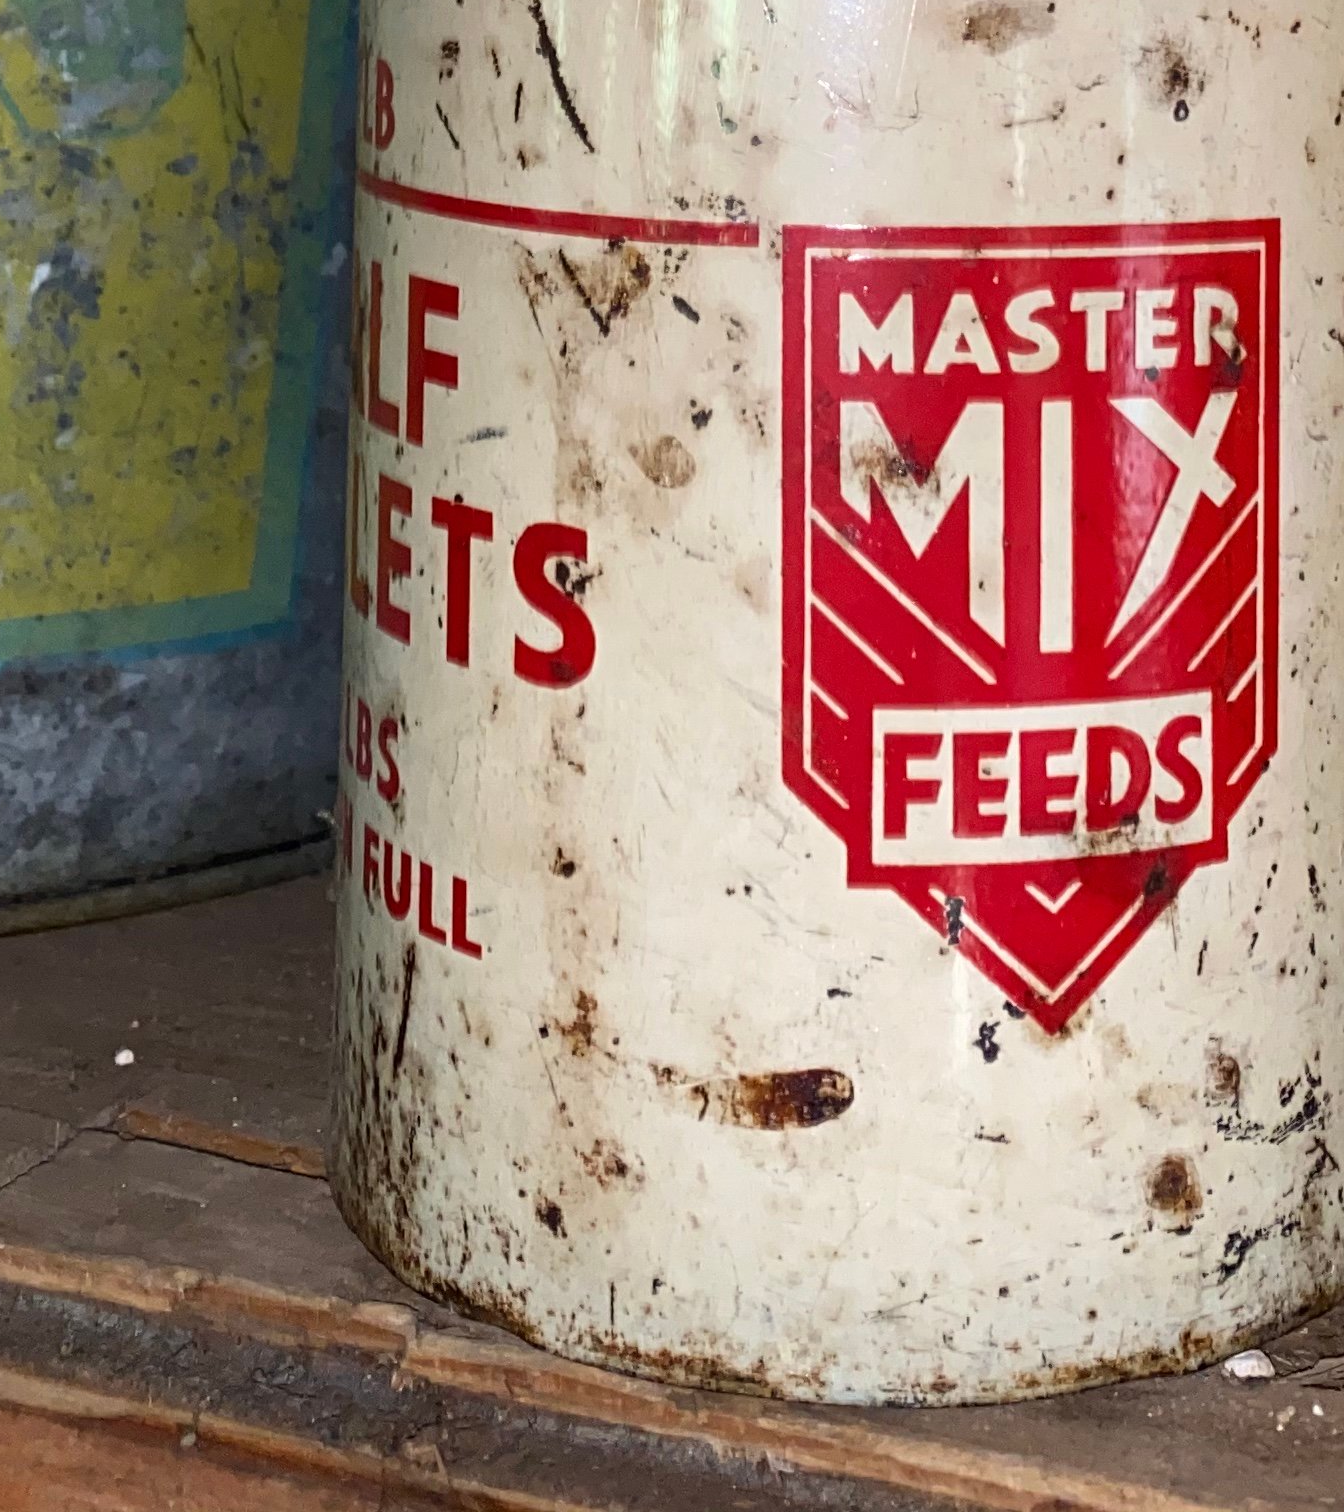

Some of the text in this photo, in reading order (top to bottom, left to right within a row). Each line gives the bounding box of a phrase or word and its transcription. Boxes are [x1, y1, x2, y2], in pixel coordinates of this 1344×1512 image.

[356, 259, 460, 448] LF
[839, 287, 1247, 375] MASTER
[839, 391, 1239, 654] MIX
[883, 715, 1205, 841] FEEDS
[362, 823, 482, 960] FULL
